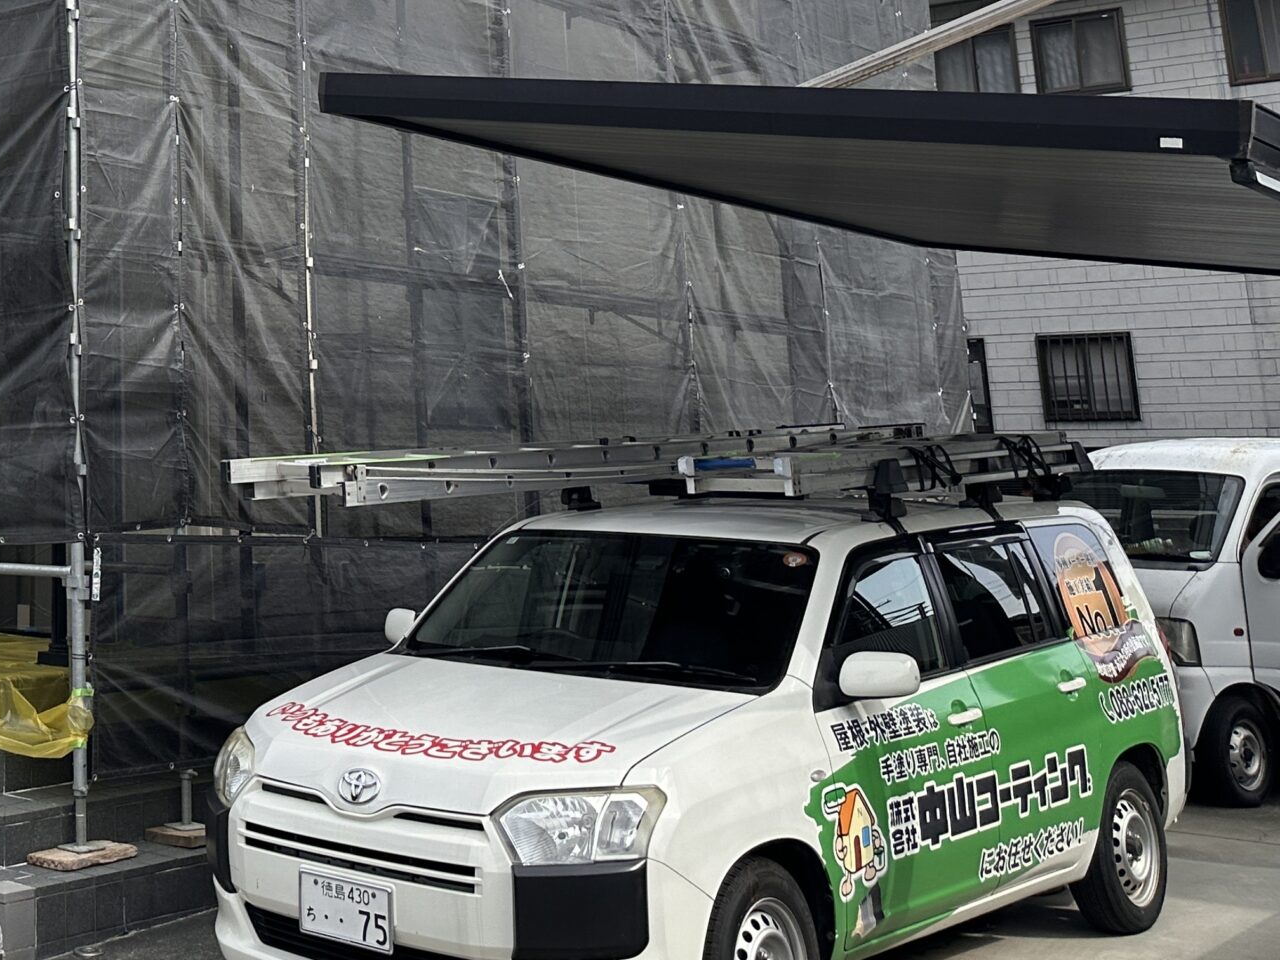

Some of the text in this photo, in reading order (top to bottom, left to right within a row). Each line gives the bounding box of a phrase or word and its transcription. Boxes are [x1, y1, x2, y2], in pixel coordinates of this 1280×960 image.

[266, 700, 616, 763] いつもありがとうございます
[830, 705, 938, 751] 屋根・外壁塗装は
[881, 730, 1001, 783] 手塗り専門、自社施工の
[888, 796, 915, 827] 株式
[920, 746, 1092, 845] 中山コーティング
[891, 824, 918, 855] 会社
[320, 880, 370, 906] 徳島 430
[306, 905, 317, 922] ち
